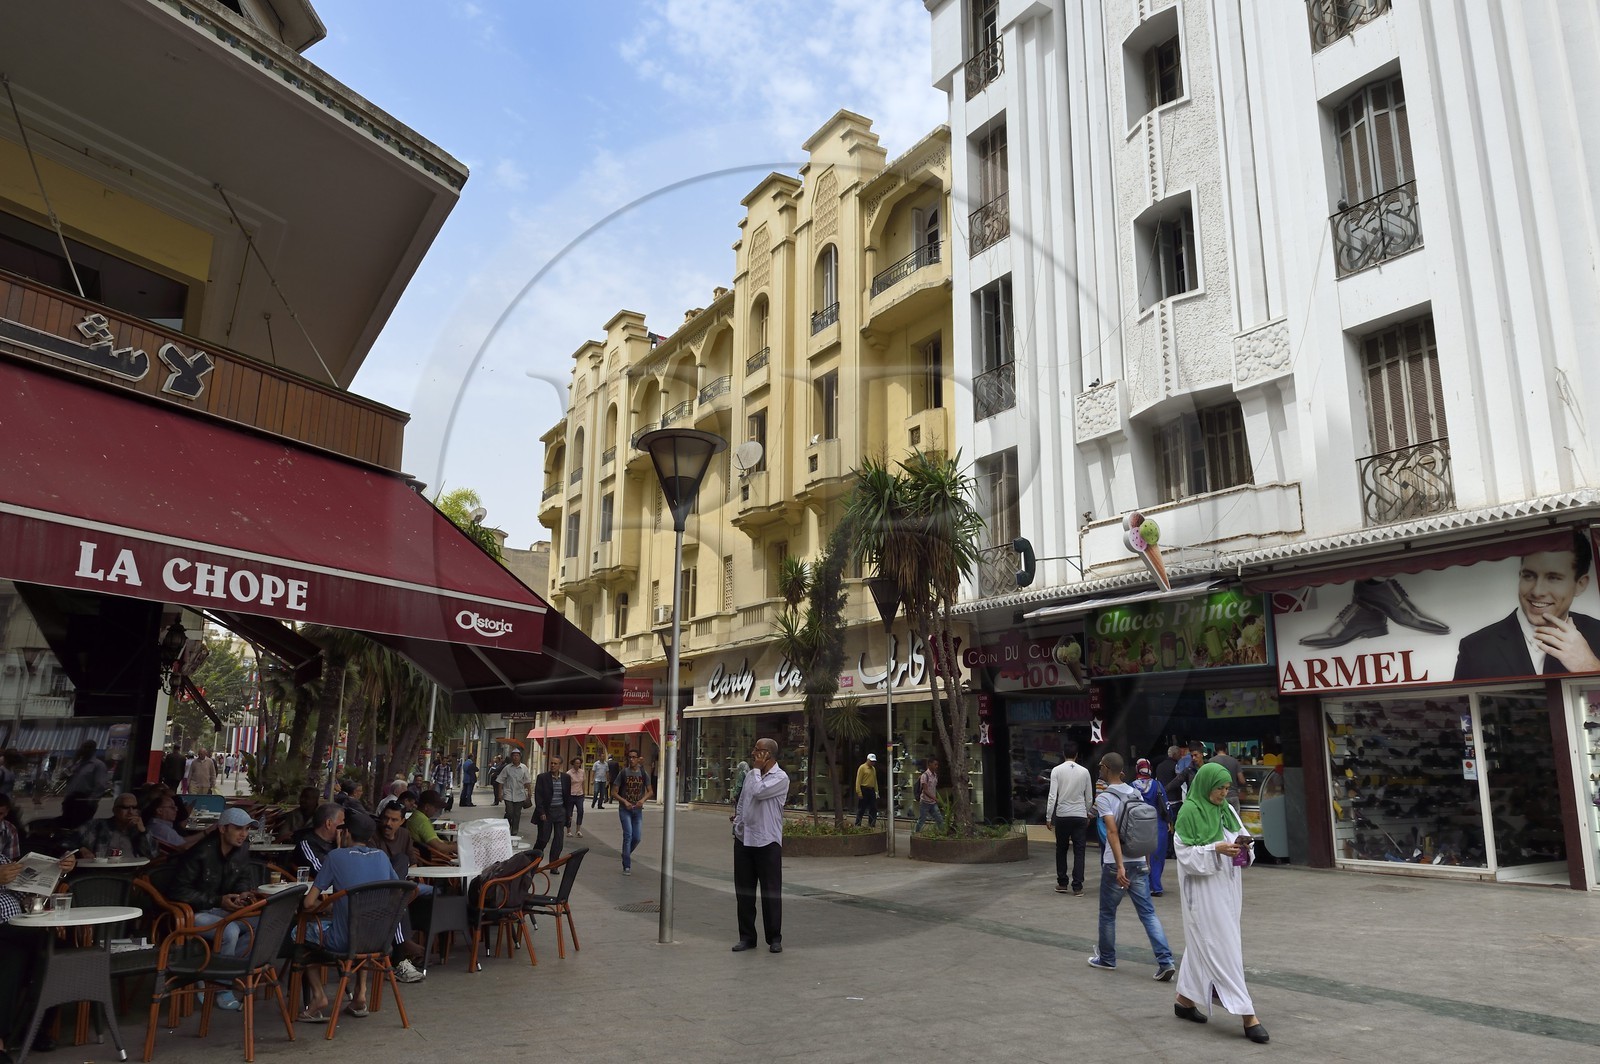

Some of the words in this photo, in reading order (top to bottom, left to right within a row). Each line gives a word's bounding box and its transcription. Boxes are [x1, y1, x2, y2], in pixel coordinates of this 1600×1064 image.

[75, 540, 142, 587] LA
[162, 557, 309, 611] CHOPE
[1095, 610, 1166, 635] Glaces
[1172, 598, 1253, 627] Prince
[1005, 645, 1019, 661] DU
[1281, 649, 1429, 691] ARMEL
[623, 688, 650, 699] Triumph
[708, 658, 755, 702] Carly
[1021, 664, 1059, 688] 100
